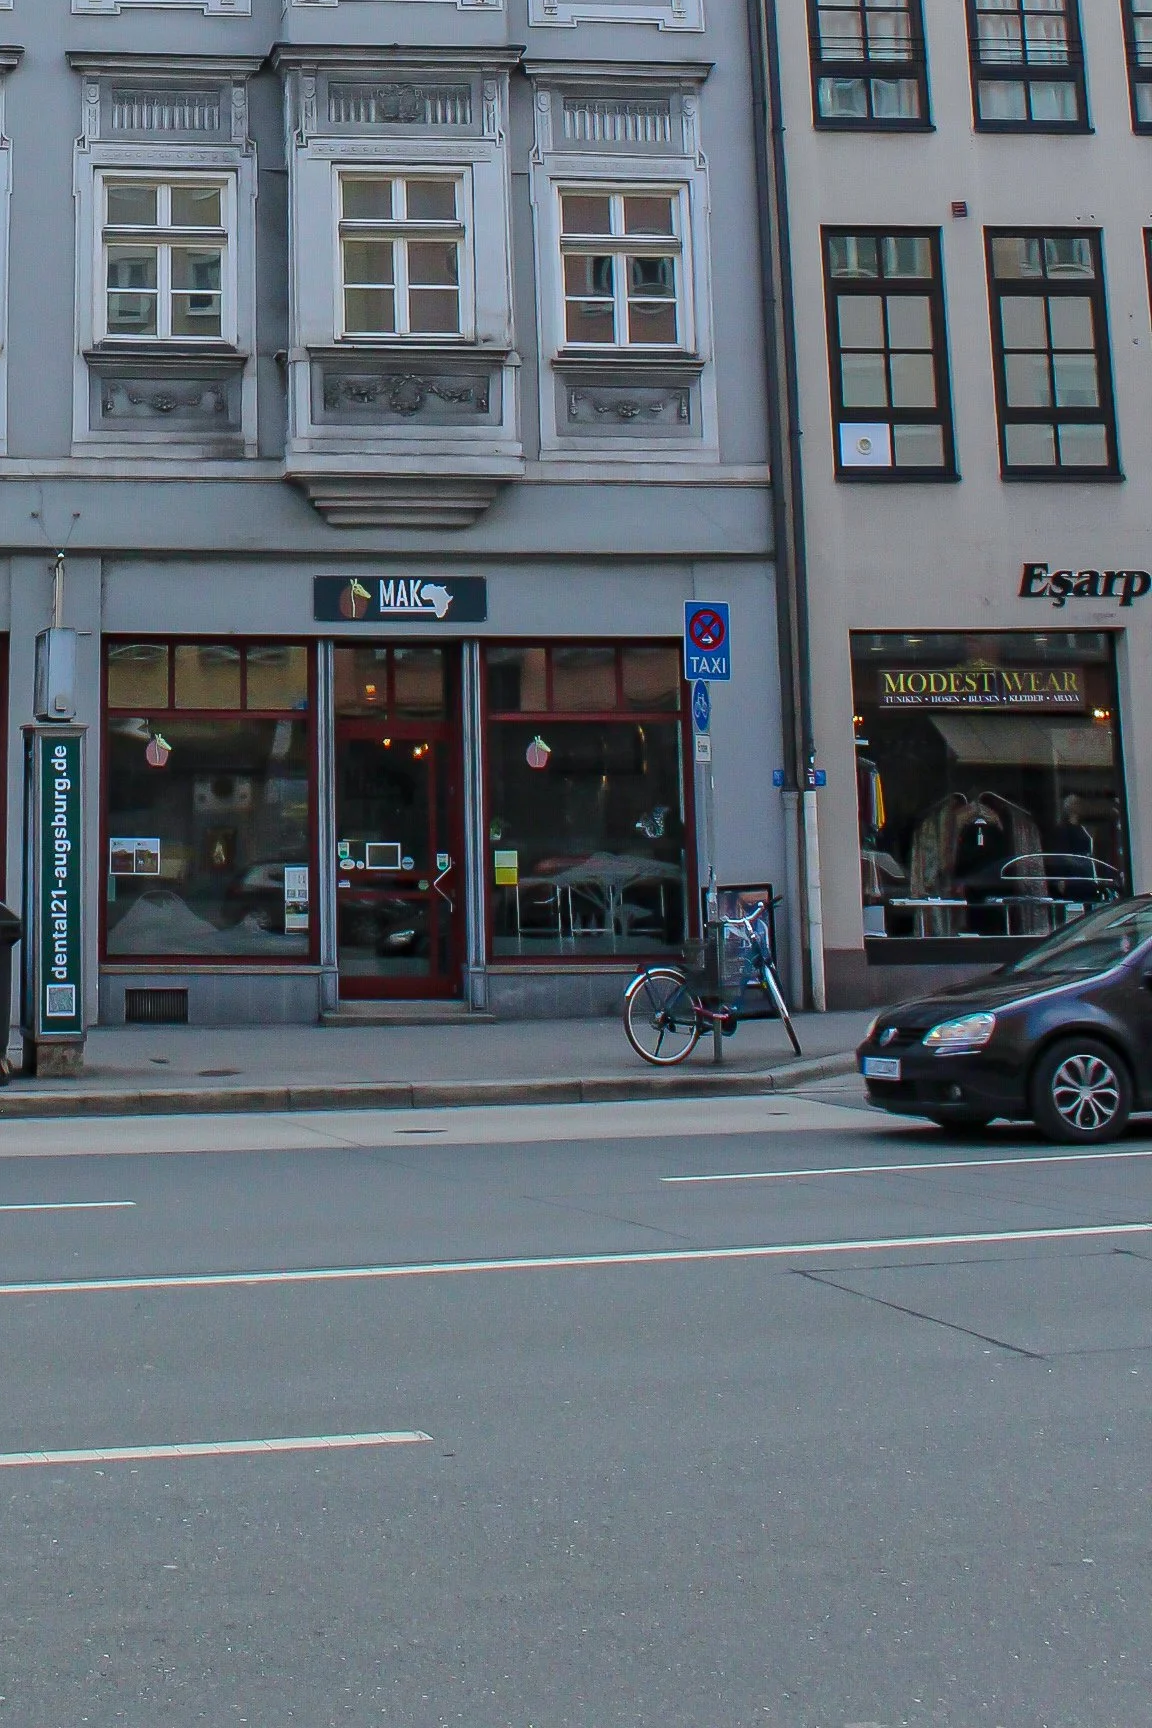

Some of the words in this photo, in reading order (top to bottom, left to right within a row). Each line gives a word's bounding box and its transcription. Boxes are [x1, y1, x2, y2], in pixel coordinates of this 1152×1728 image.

[1018, 562, 1152, 608] Eşarp
[689, 656, 726, 674] TAXI
[883, 672, 995, 693] MODEST
[1001, 672, 1079, 692] WEAR
[931, 695, 960, 703] HOSEN
[968, 695, 1000, 703] BLUSEN
[1009, 694, 1044, 703] KLEIDER
[50, 745, 71, 980] dental21-augsburg.de
